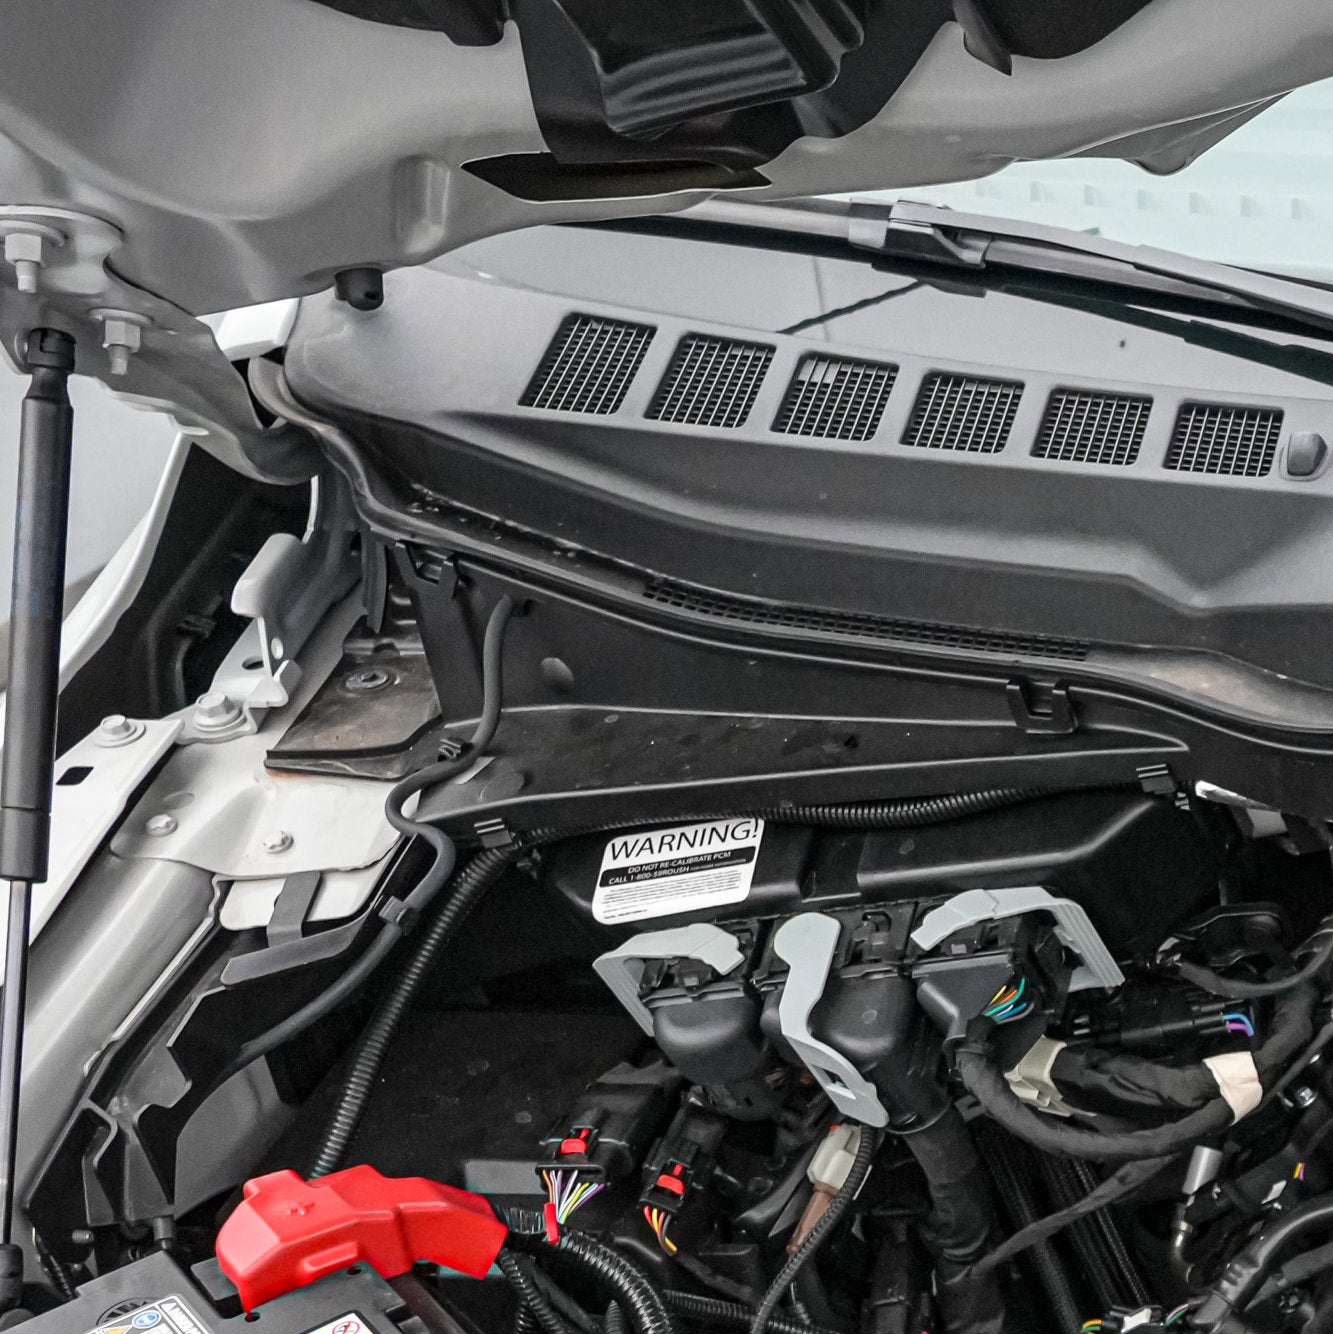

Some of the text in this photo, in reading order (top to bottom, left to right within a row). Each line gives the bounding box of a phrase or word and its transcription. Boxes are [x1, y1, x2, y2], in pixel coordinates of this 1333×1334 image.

[610, 818, 757, 860] WARNING!
[628, 851, 731, 874] DO NOT RE-CALIBRATE PCM
[609, 876, 628, 885] CALL
